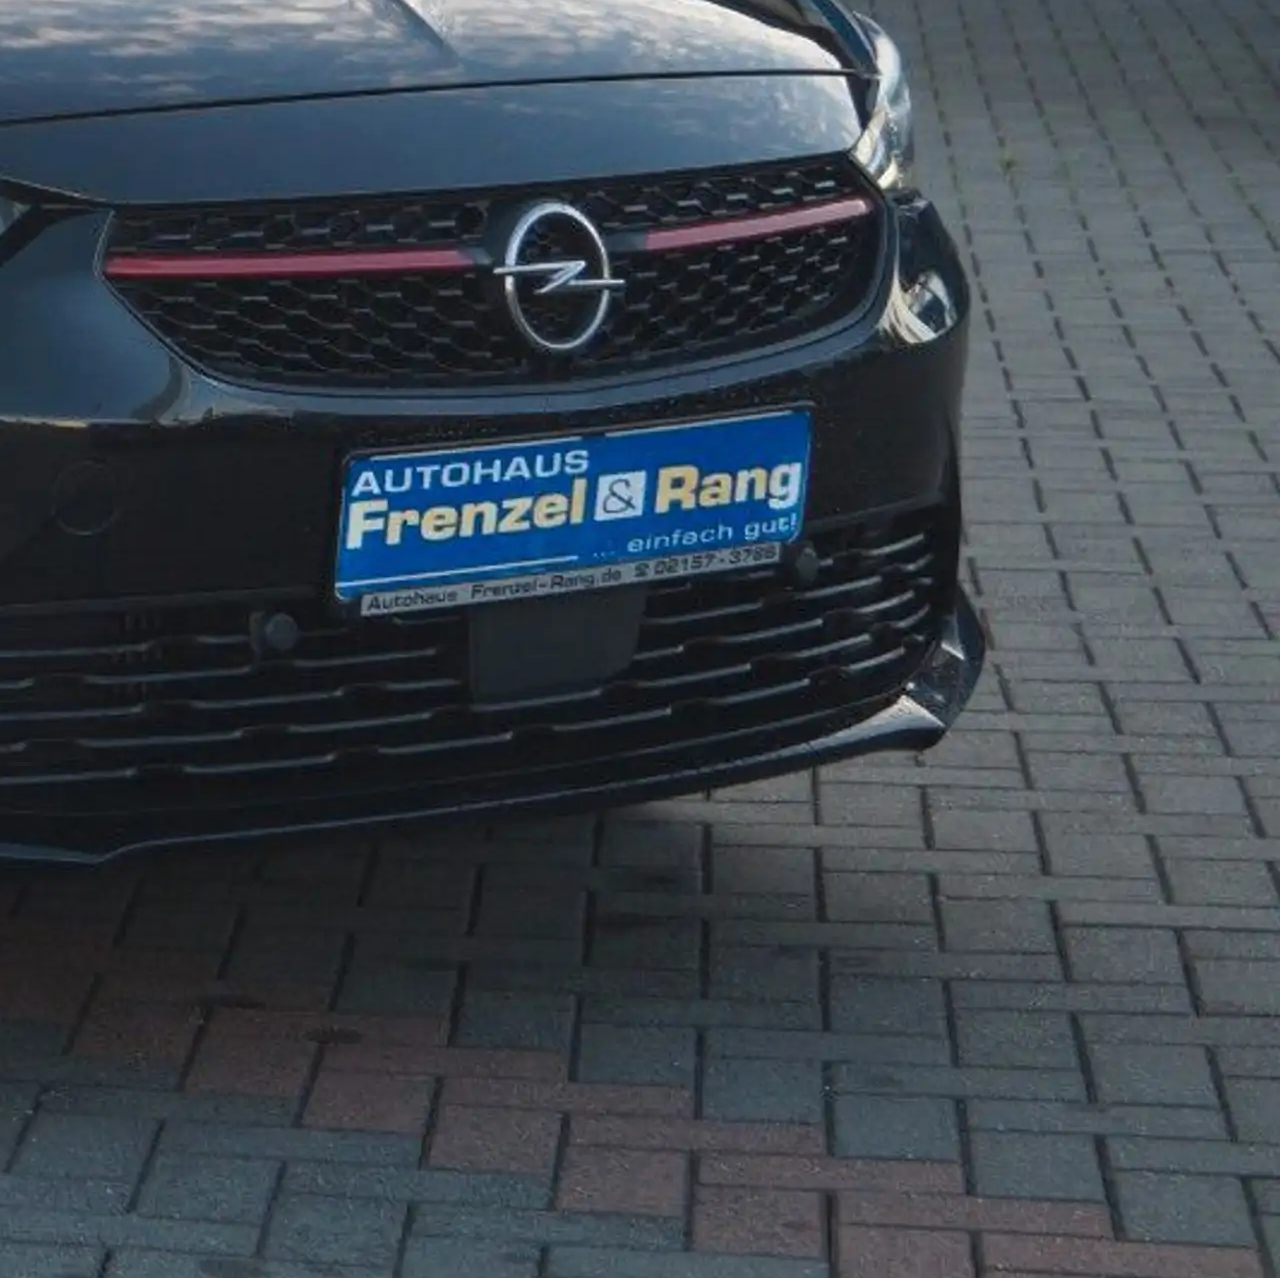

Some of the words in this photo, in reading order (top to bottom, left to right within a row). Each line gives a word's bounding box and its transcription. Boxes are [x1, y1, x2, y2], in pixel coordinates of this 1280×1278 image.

[351, 449, 589, 496] AUTOHAUS
[346, 478, 587, 550] Frenzel
[654, 461, 802, 514] Rang
[627, 524, 733, 553] einfach
[744, 512, 797, 541] gut!
